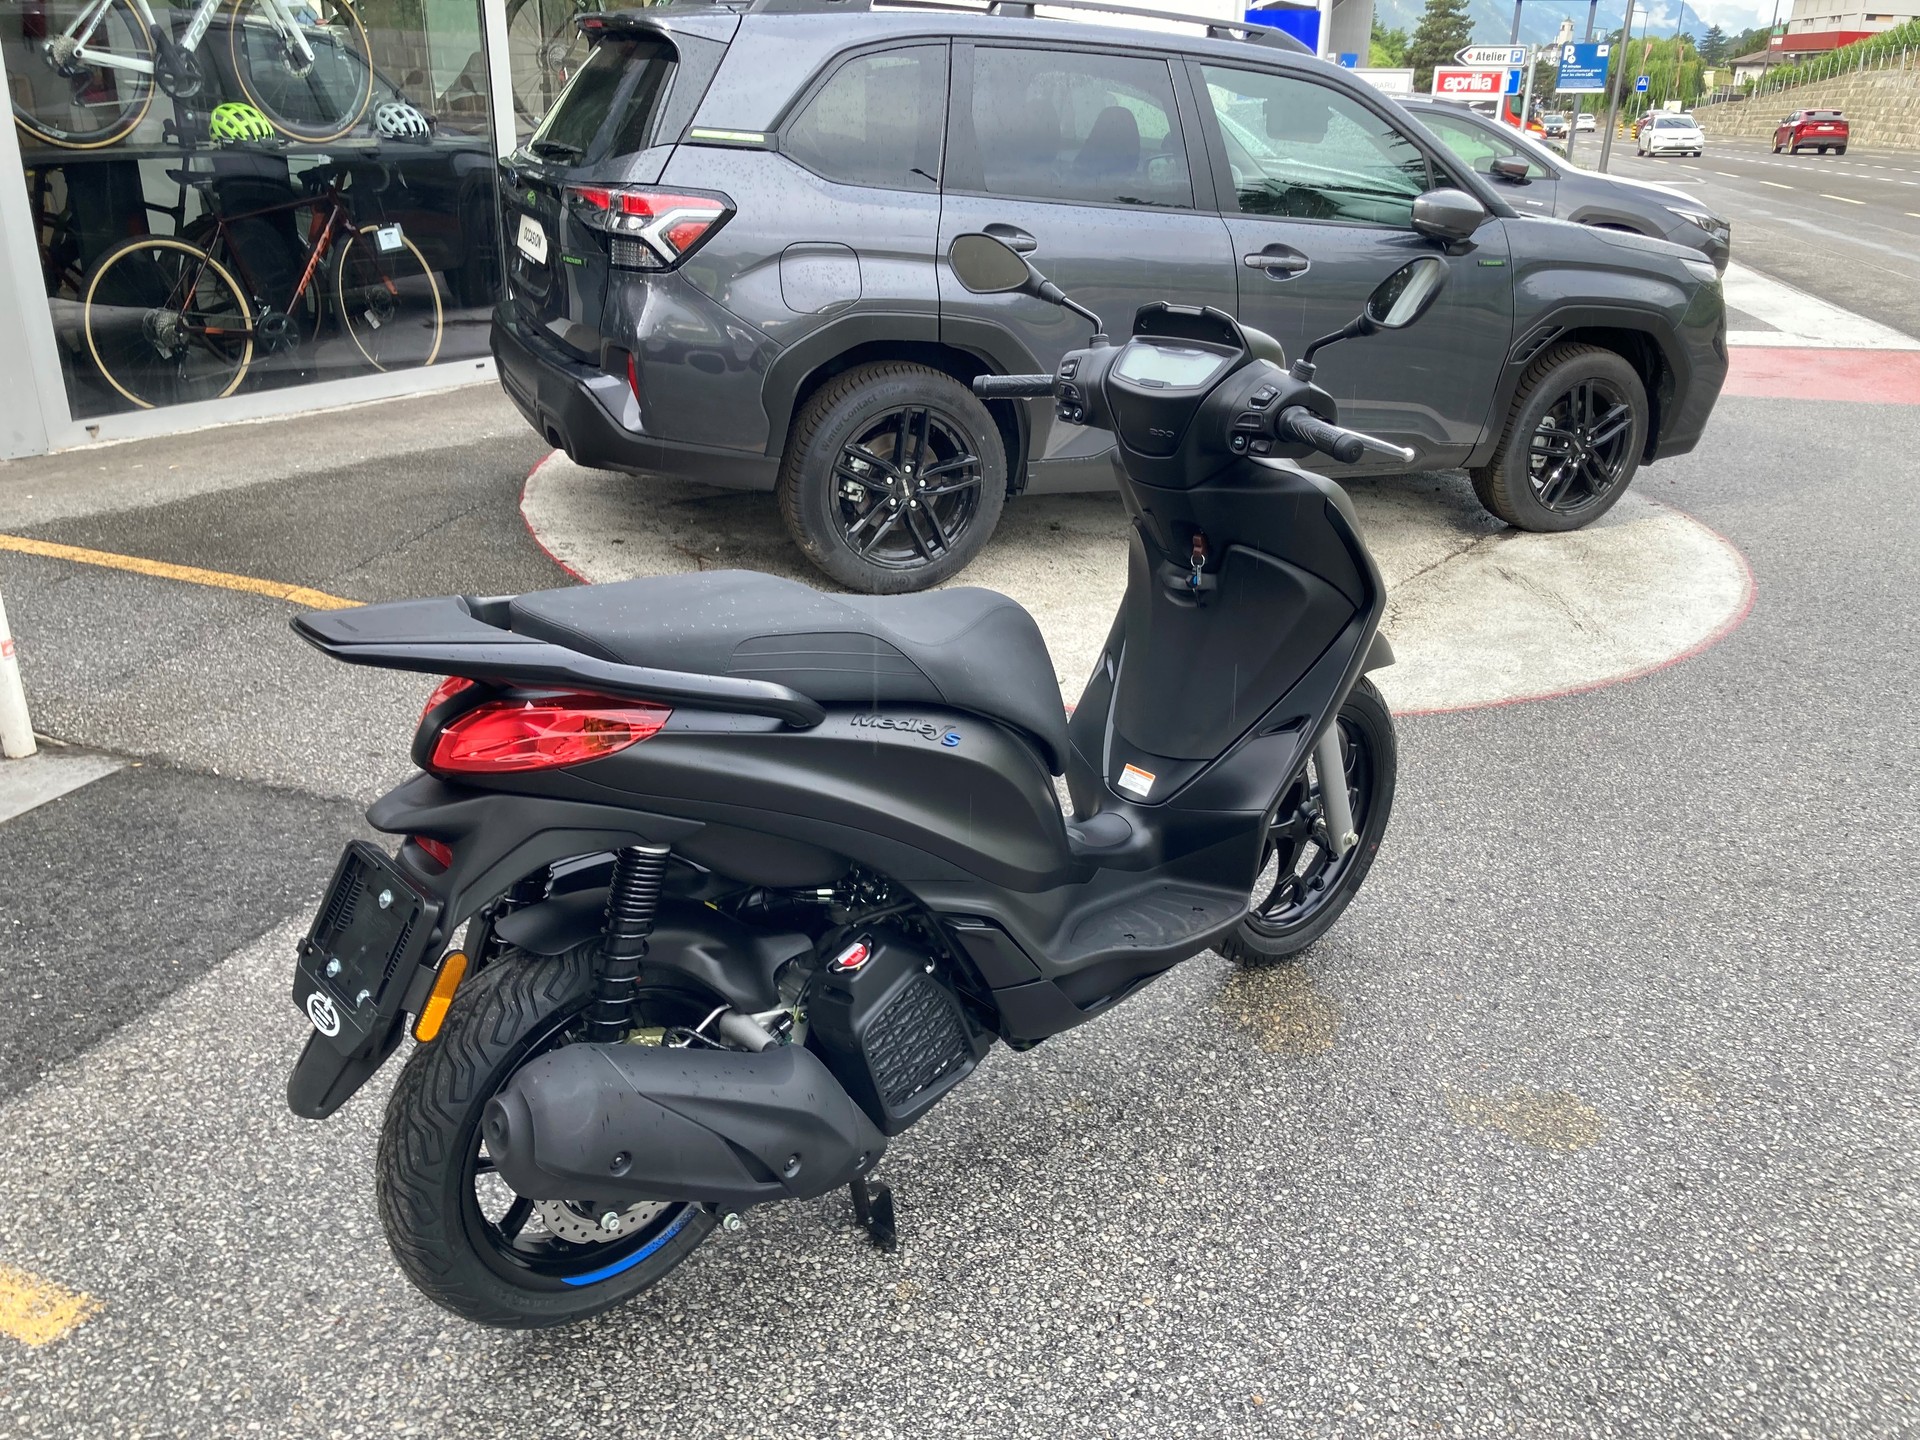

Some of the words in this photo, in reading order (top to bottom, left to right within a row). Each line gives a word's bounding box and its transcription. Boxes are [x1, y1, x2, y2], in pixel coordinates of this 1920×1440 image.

[1475, 51, 1506, 61] Atelier
[1443, 73, 1492, 93] aprilia
[523, 226, 543, 250] OCCASION
[850, 712, 956, 742] Medley
